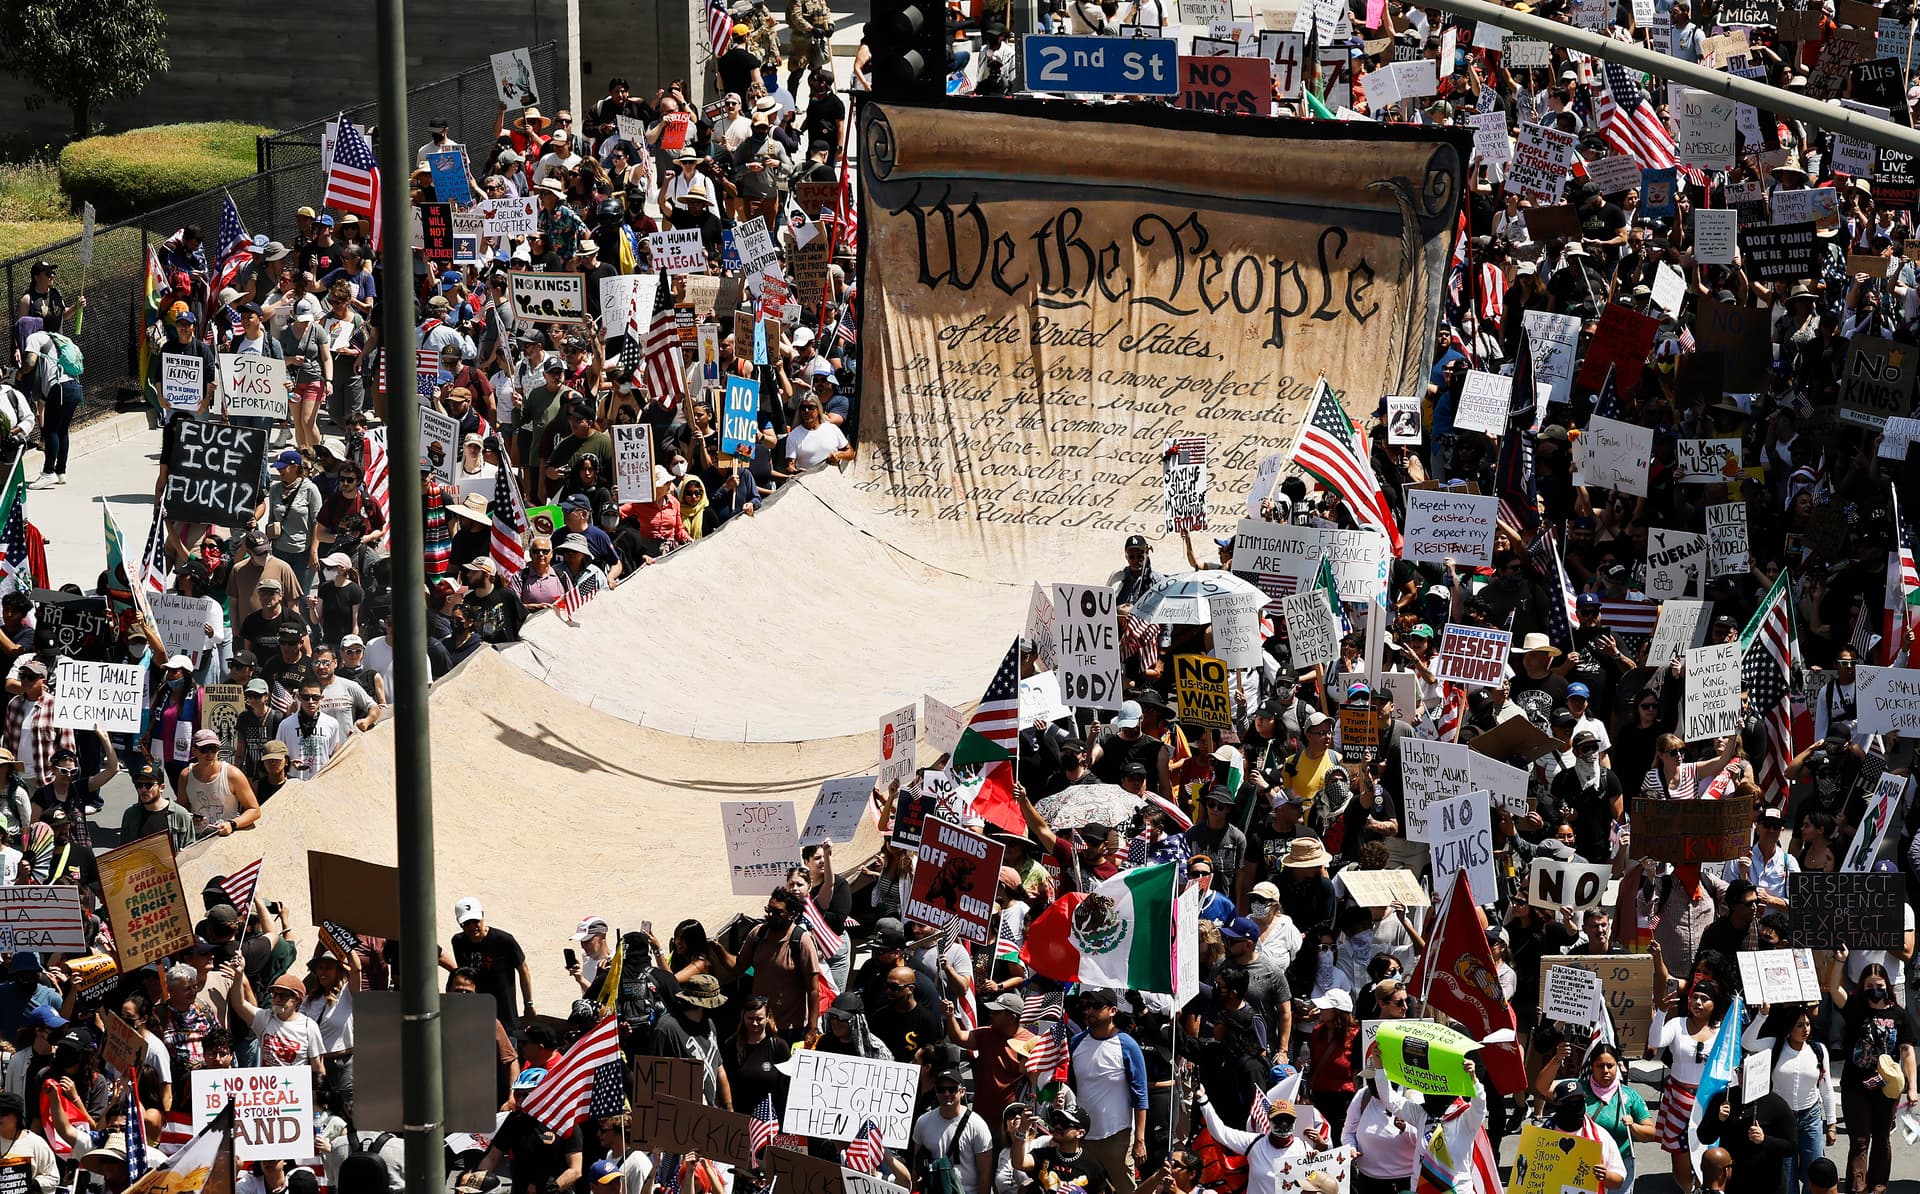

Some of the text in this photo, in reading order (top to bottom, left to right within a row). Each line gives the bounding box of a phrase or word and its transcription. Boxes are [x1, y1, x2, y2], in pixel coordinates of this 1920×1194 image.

[1736, 10, 1769, 22] MIGRA
[1394, 45, 1419, 60] PEOPLE
[1040, 46, 1163, 82] 2nd St
[1275, 41, 1298, 91] 4
[1189, 64, 1231, 87] NO
[1859, 65, 1895, 82] Alts
[1686, 104, 1701, 115] NO
[1522, 124, 1574, 147] THE POWER
[1532, 135, 1565, 153] OF THE
[1517, 142, 1550, 160] PEOPLE
[1880, 150, 1913, 161] LONG
[1513, 163, 1558, 184] THAN THE
[1517, 154, 1568, 177] STRONGER
[1883, 163, 1907, 174] LIVE
[1509, 172, 1542, 190] PEOPLE
[1726, 185, 1744, 193] THIS
[430, 206, 441, 215] WE
[492, 199, 524, 209] FAMILIES
[429, 217, 446, 226] WILL
[498, 210, 523, 221] BELONG
[430, 228, 445, 236] NOT
[454, 220, 484, 230] MAGA
[490, 219, 533, 233] TOGETHER
[434, 238, 442, 247] BE
[652, 232, 698, 246] NO HUMAN
[1746, 232, 1813, 247] DON'T PANIC
[654, 255, 703, 272] ILLEGAL
[1753, 249, 1811, 260] WE'RE JUST
[889, 182, 1379, 349] We the People
[1760, 264, 1809, 277] HISPANIC
[1031, 317, 1225, 362] United States,
[168, 368, 197, 381] KING
[233, 357, 272, 376] STOP
[232, 375, 272, 394] MASS
[939, 358, 1271, 399] order more perfect
[731, 386, 752, 411] NO
[1846, 380, 1905, 410] KINGS
[224, 394, 287, 415] DEPORTATION
[1103, 396, 1294, 425] insure domestic
[424, 414, 451, 430] REMEMBER
[1017, 412, 1128, 436] the common
[180, 421, 253, 454] FUCK
[617, 427, 645, 441] NO
[181, 444, 243, 477] ICE
[620, 452, 646, 460] KING
[1691, 455, 1719, 474] USA
[1088, 472, 1135, 488] and
[1164, 465, 1200, 485] STAYING
[1169, 480, 1196, 498] SILENT
[1013, 487, 1114, 510] establish
[1174, 492, 1197, 508] TIMES
[1410, 497, 1476, 515] Respect my
[1432, 514, 1489, 526] existence
[1709, 504, 1747, 525] NO ICE
[1166, 520, 1174, 534] IS
[1410, 527, 1489, 543] or expect my
[1718, 527, 1739, 538] JUST
[1319, 530, 1364, 546] FIGHT
[1653, 533, 1666, 548] Y
[1414, 542, 1487, 558] RESISTANCE!
[1712, 541, 1747, 558] MODELO
[1252, 556, 1281, 573] ARE
[1060, 585, 1113, 618] YOU
[1216, 596, 1253, 607] TRUMP
[1287, 592, 1322, 617] ANNE
[1287, 608, 1331, 631] FRANK
[1061, 623, 1114, 656] HAVE
[1226, 636, 1249, 646] YOU
[1293, 625, 1328, 642] WROTE
[1447, 628, 1509, 642] CHOOSE LOVE
[1296, 633, 1330, 653] ABOUT
[1444, 636, 1507, 660] RESIST
[1670, 642, 1686, 659] ALL
[1076, 655, 1096, 666] THE
[1300, 643, 1333, 664] THIS!
[1695, 646, 1733, 663] IF WE
[59, 662, 138, 686] THE TAMALE
[1176, 659, 1225, 685] NO
[1441, 656, 1502, 684] TRUMP
[1689, 660, 1739, 677] WANTED A
[1065, 670, 1119, 702] BODY
[1702, 676, 1727, 689] KING,
[61, 685, 140, 704] LADY IS NOT
[1182, 692, 1228, 712] WAR
[1687, 685, 1741, 703] WE WOULD'VE
[59, 705, 137, 721] A CRIMINAL
[1184, 708, 1200, 717] ON
[1687, 711, 1716, 739] JASON
[1441, 768, 1469, 784] ALWAYS
[743, 806, 778, 824] STOP
[1443, 800, 1473, 832] NO
[938, 826, 987, 859] HANDS
[920, 844, 948, 866] OFF
[1436, 830, 1490, 879] KINGS
[128, 867, 157, 885] SUPER
[134, 872, 177, 893] CALLOUS
[1797, 875, 1887, 895] RESPECT
[125, 882, 173, 910] FRAGILE
[1539, 868, 1602, 908] NO
[130, 894, 177, 919] RACIST
[960, 894, 990, 917] OUR
[1790, 892, 1897, 910] EXISTENCE
[4, 908, 32, 921] LA
[127, 907, 171, 933] SEXIST
[1835, 908, 1850, 917] OR
[131, 916, 179, 943] TRUMP
[1804, 915, 1880, 932] EXPECT
[141, 938, 160, 952] NOT
[1792, 931, 1899, 949] RESISTANCE
[143, 937, 190, 963] POTUS
[798, 1055, 916, 1091] FIRST THEIR
[1404, 1065, 1447, 1083] did nothing
[224, 1076, 277, 1092] NO ONE
[1414, 1077, 1431, 1090] stop
[811, 1085, 913, 1115] RIGHTS
[654, 1101, 751, 1161] FUCK ICE
[788, 1107, 848, 1137] THEN
[1535, 1151, 1561, 1162] STRONG
[1531, 1162, 1553, 1172] STAND
